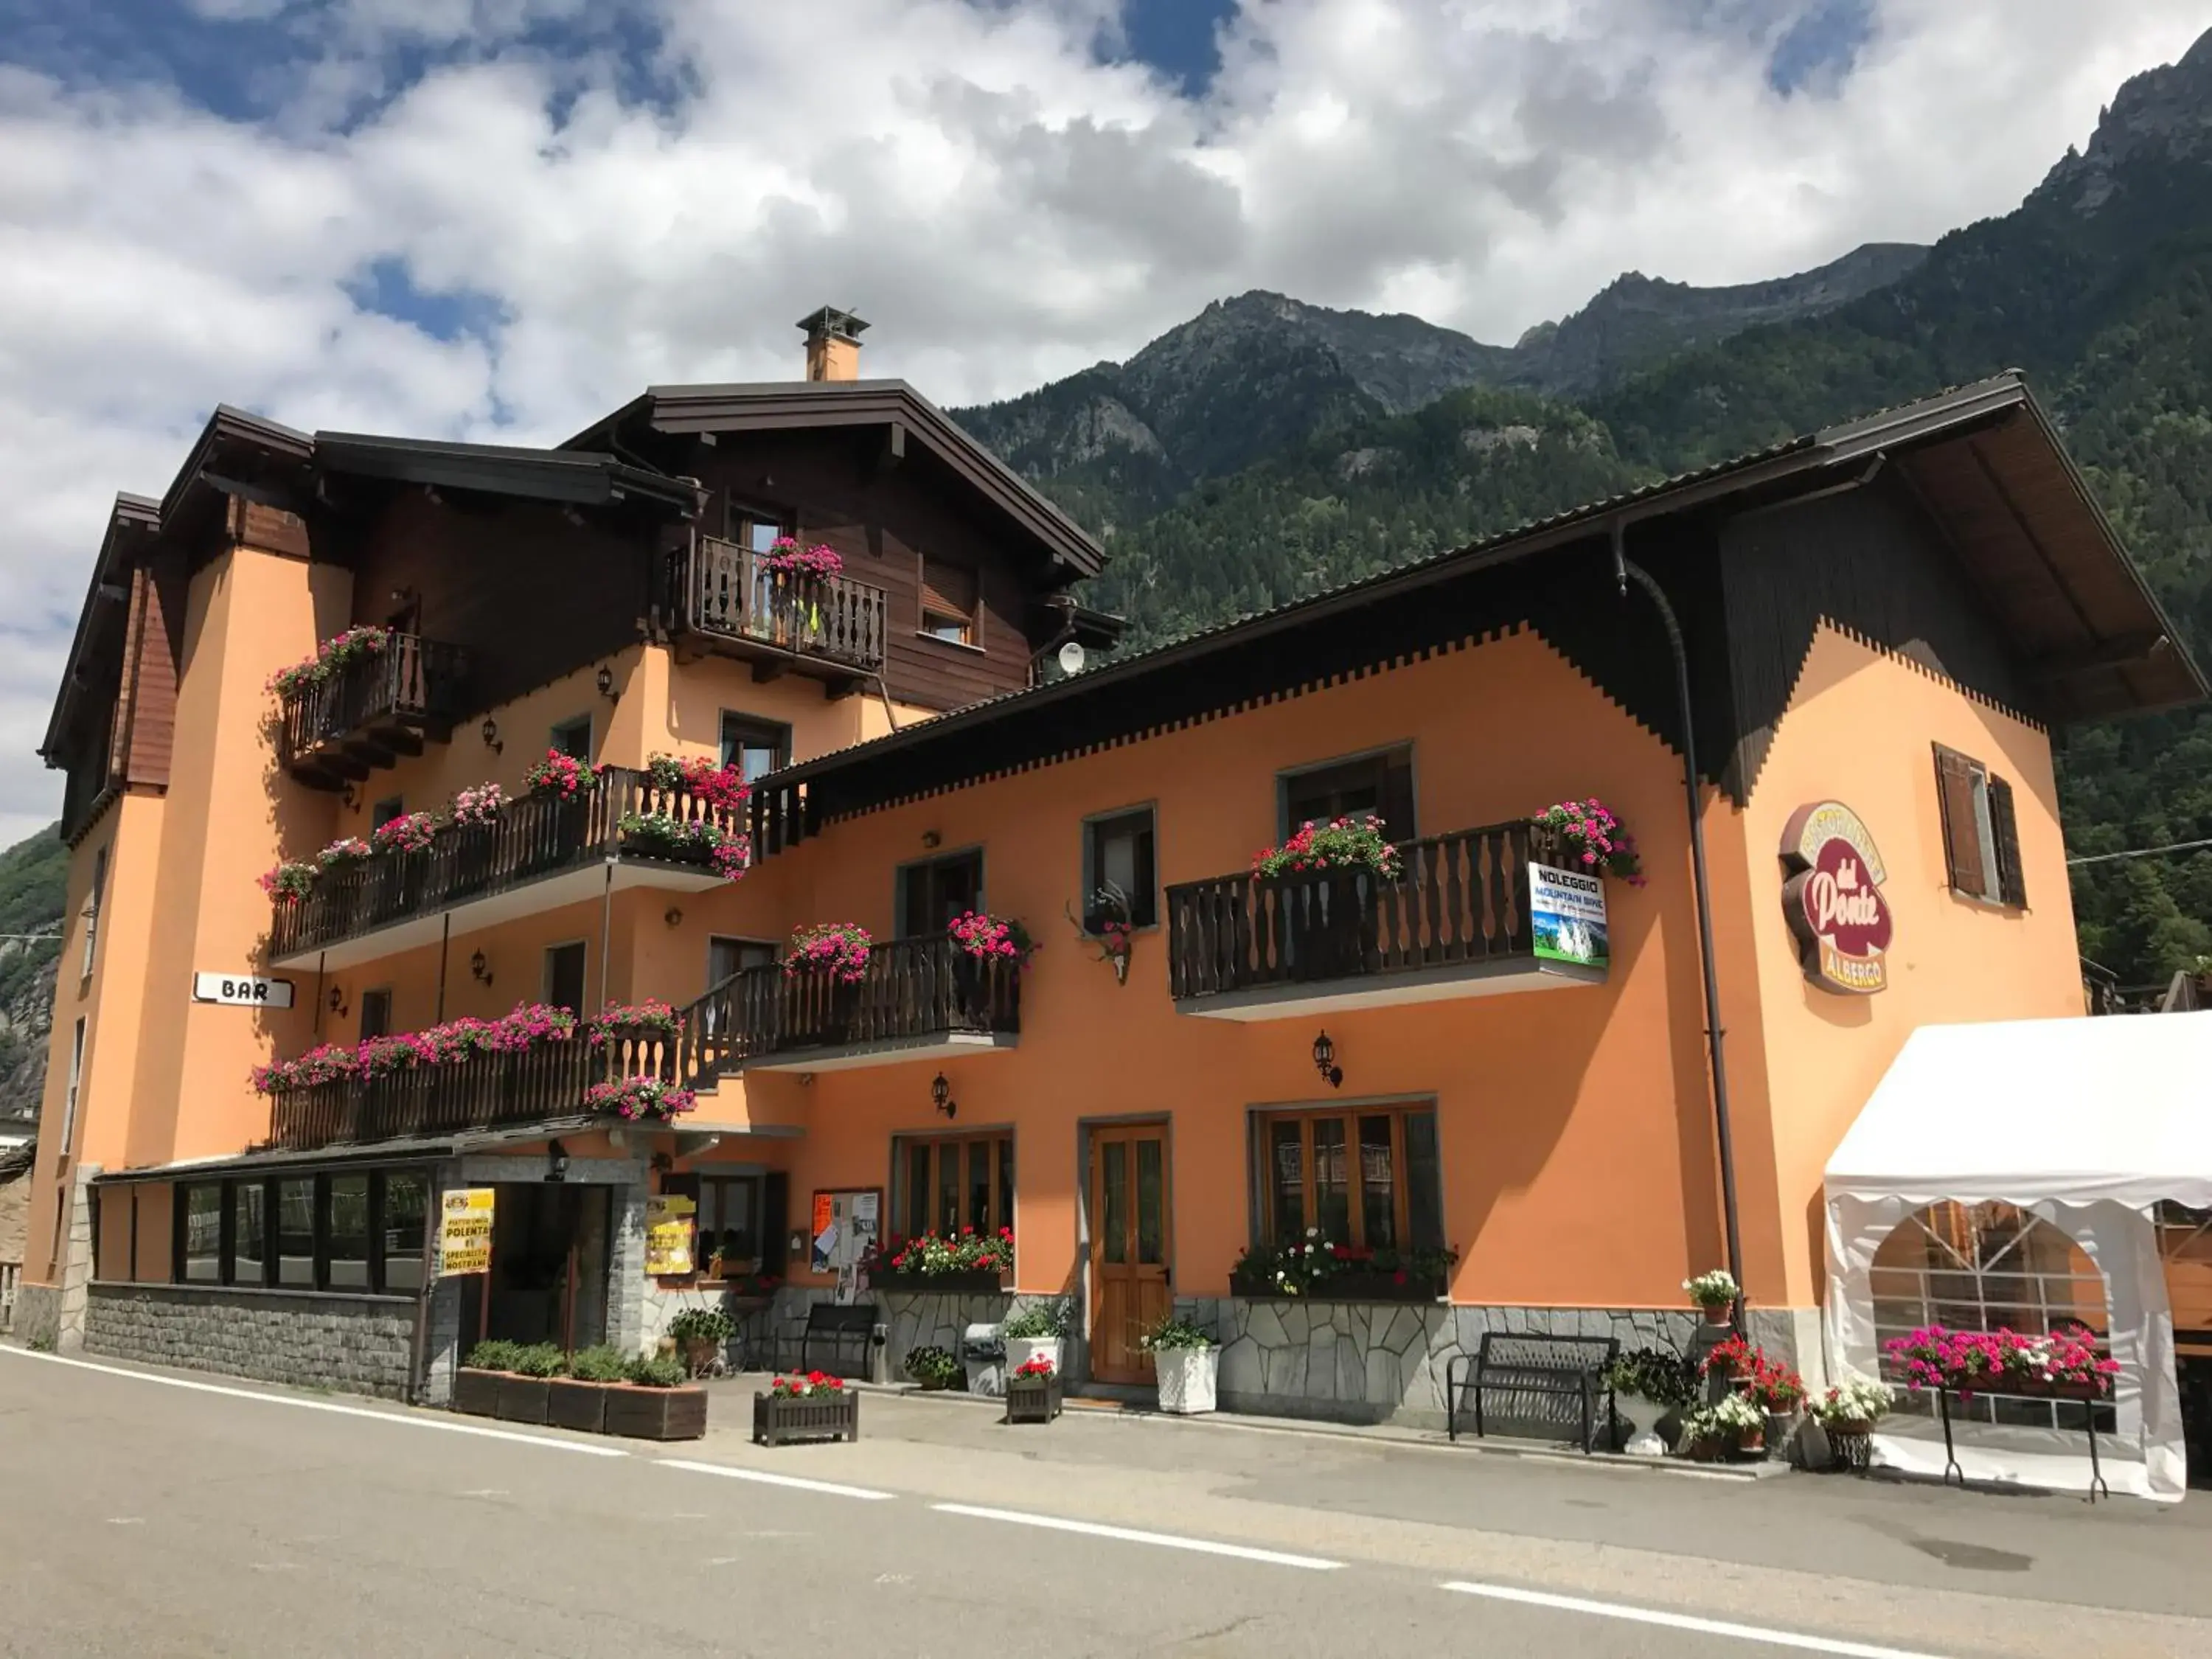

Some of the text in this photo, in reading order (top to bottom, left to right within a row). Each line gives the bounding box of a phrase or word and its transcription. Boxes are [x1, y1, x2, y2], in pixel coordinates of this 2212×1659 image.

[1538, 869, 1599, 893] NOLEGGIO
[1836, 857, 1859, 889] del
[1535, 886, 1582, 904] MOUNTAIN
[1811, 871, 1879, 931] Ponte
[1826, 949, 1882, 987] ALBERGO
[222, 979, 268, 1001] BAR
[446, 1226, 488, 1238] POLENTA
